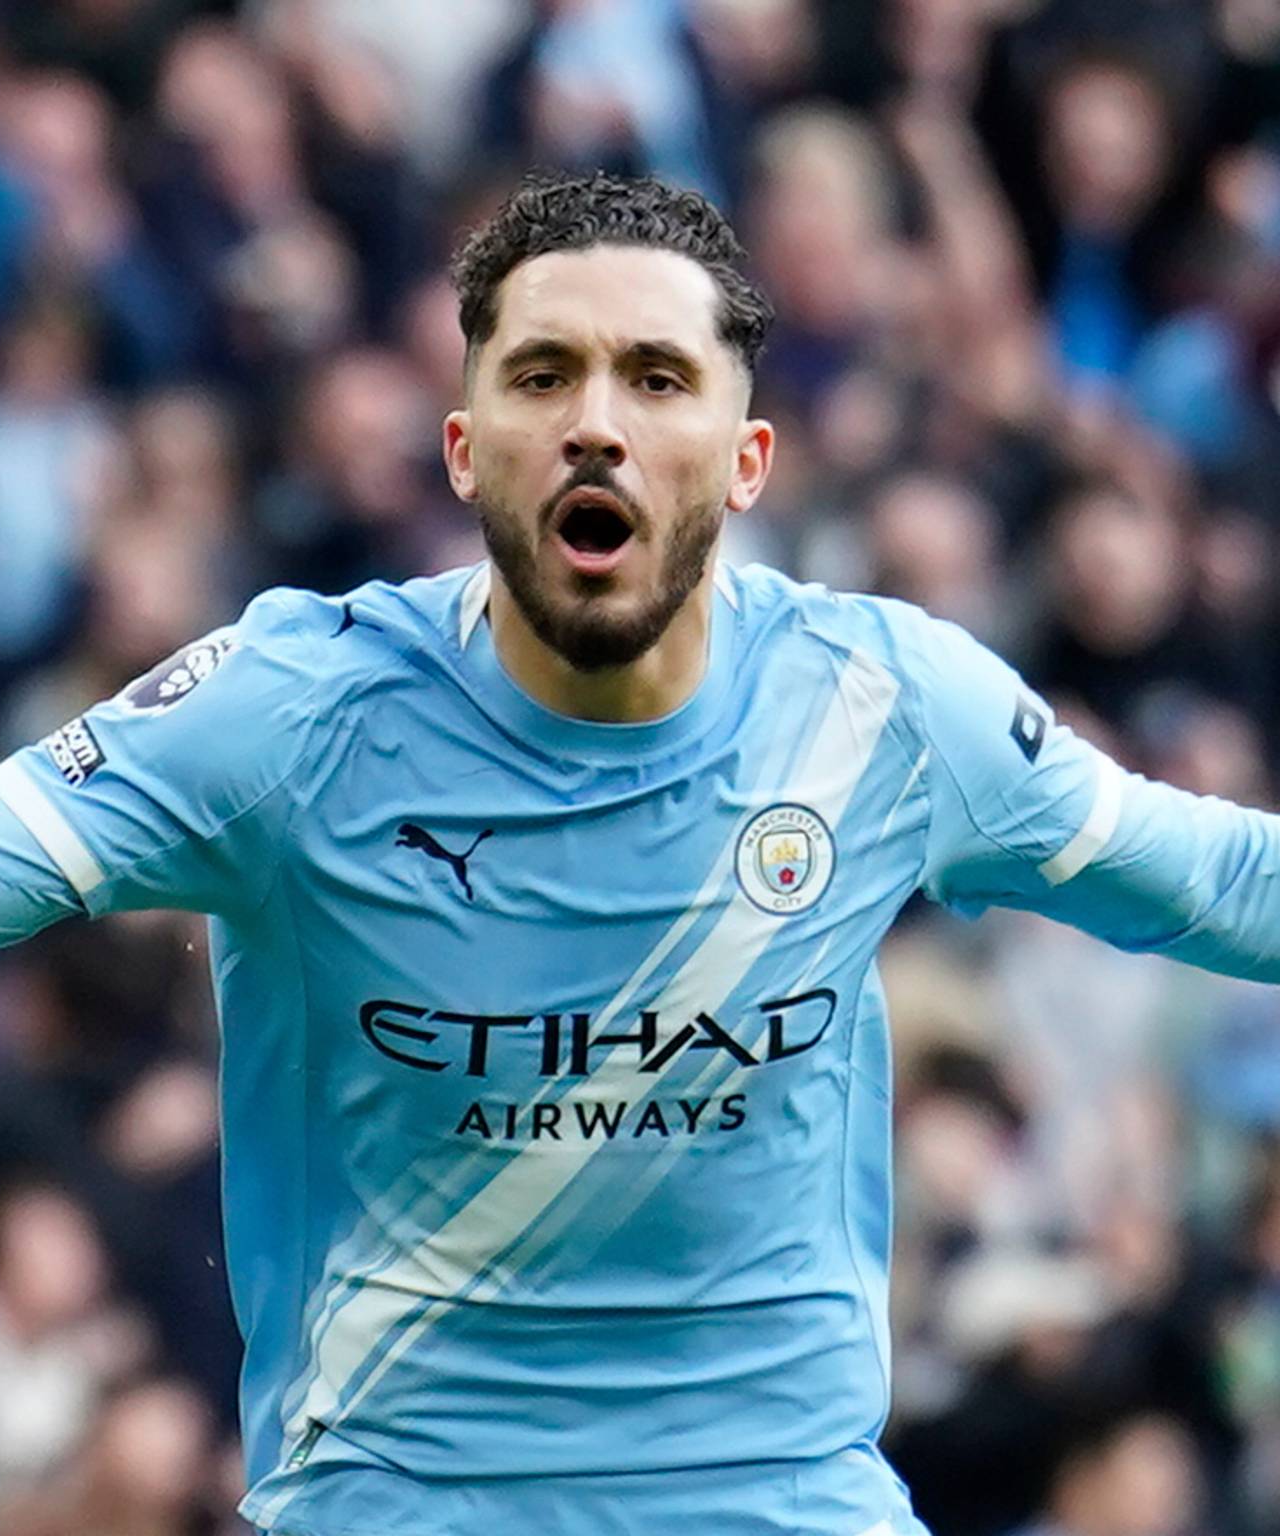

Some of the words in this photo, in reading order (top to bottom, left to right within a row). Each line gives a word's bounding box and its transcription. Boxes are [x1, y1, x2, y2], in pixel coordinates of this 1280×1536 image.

[745, 811, 823, 848] MANCHESTER
[773, 896, 803, 909] CITY
[359, 988, 837, 1077] ETIHAD
[455, 1094, 746, 1141] AIRWAYS
